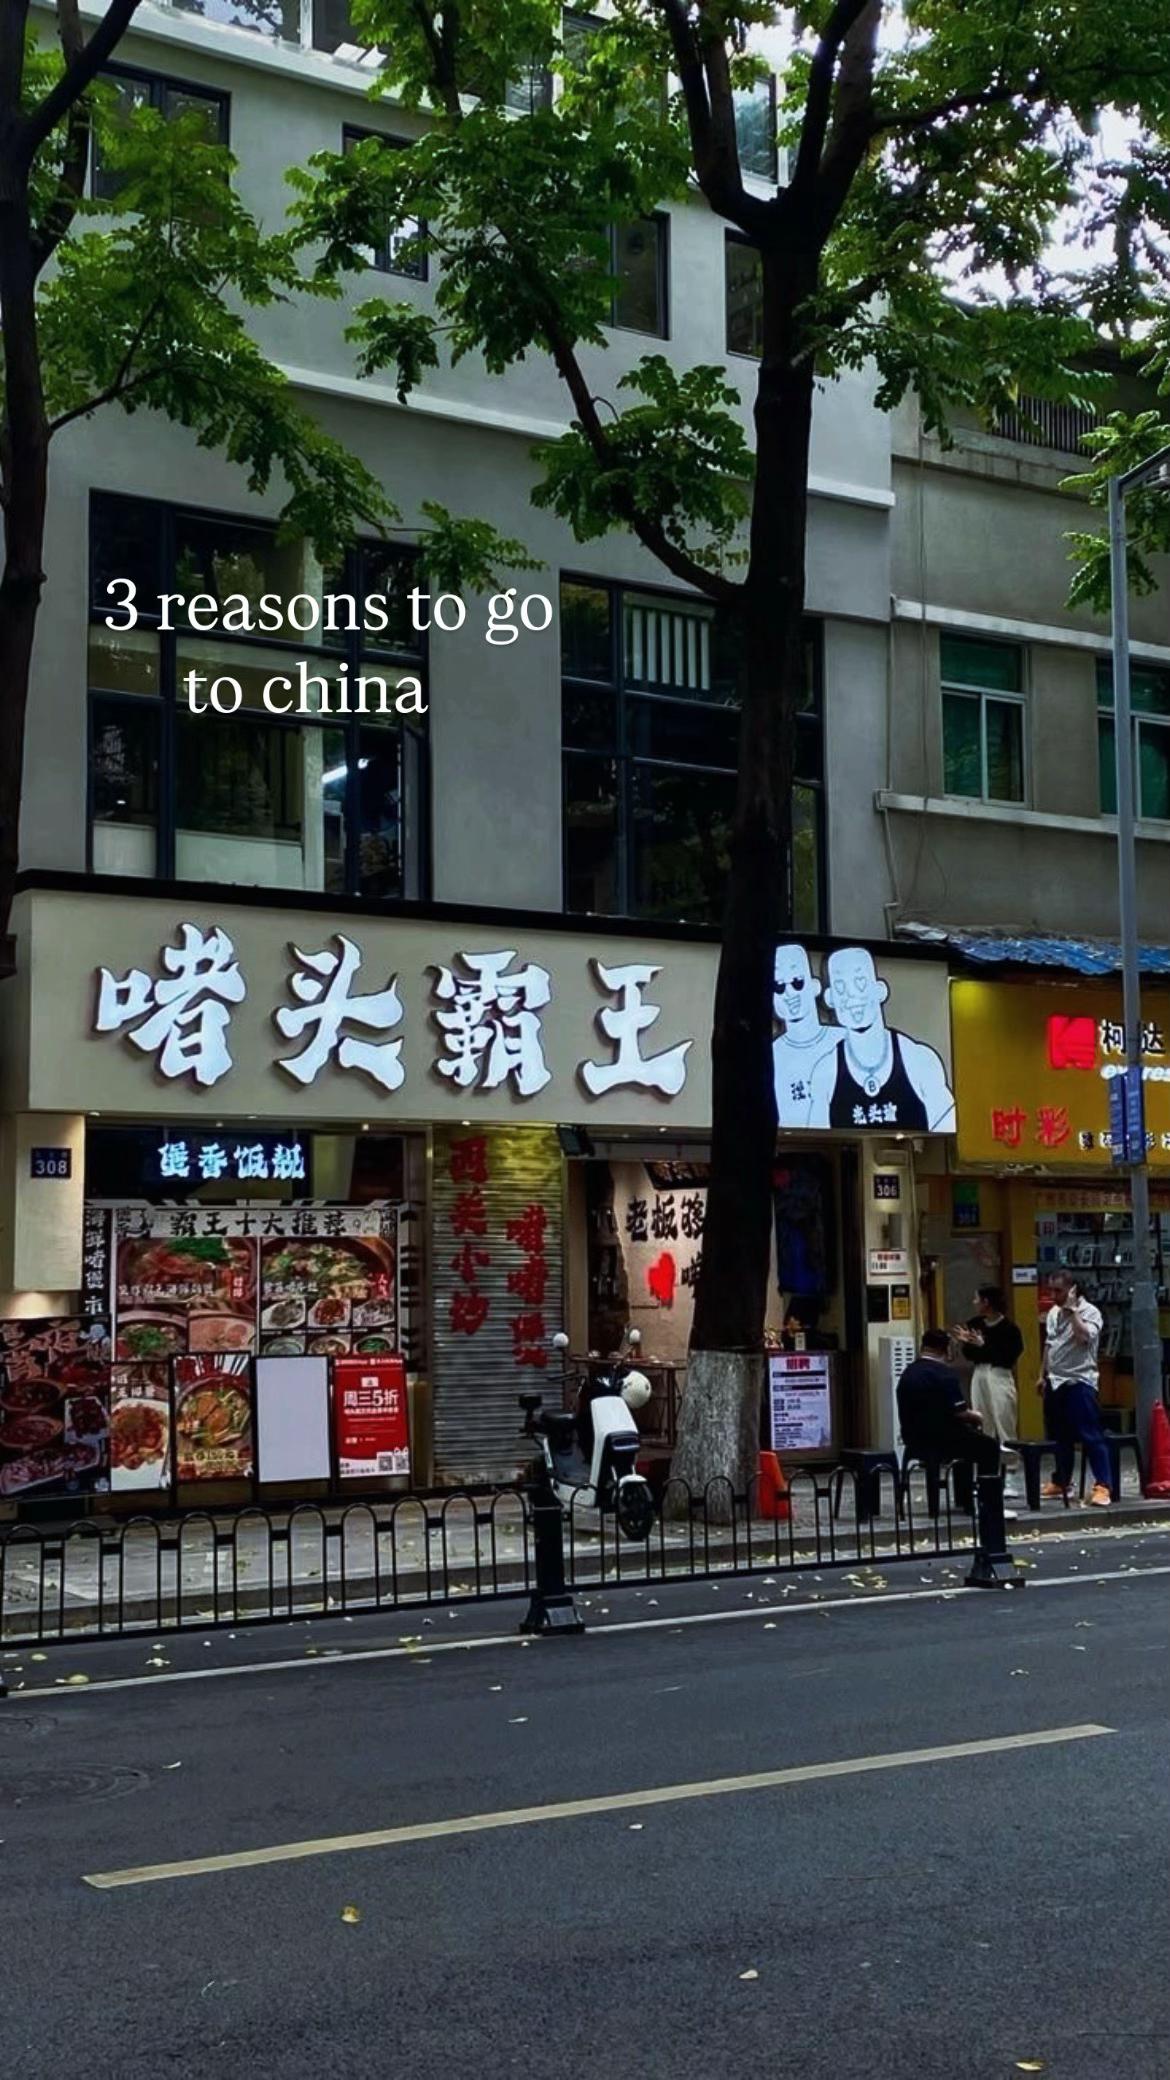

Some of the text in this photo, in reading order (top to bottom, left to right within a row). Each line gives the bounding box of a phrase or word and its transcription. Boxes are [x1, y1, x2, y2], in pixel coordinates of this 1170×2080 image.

[1098, 1019, 1166, 1057] 柯达
[992, 1105, 1072, 1148] 时彩
[34, 1159, 68, 1175] 308
[876, 1184, 897, 1197] 306
[170, 1210, 347, 1237] 霸王十大推荐
[344, 1390, 399, 1407] 周三5折
